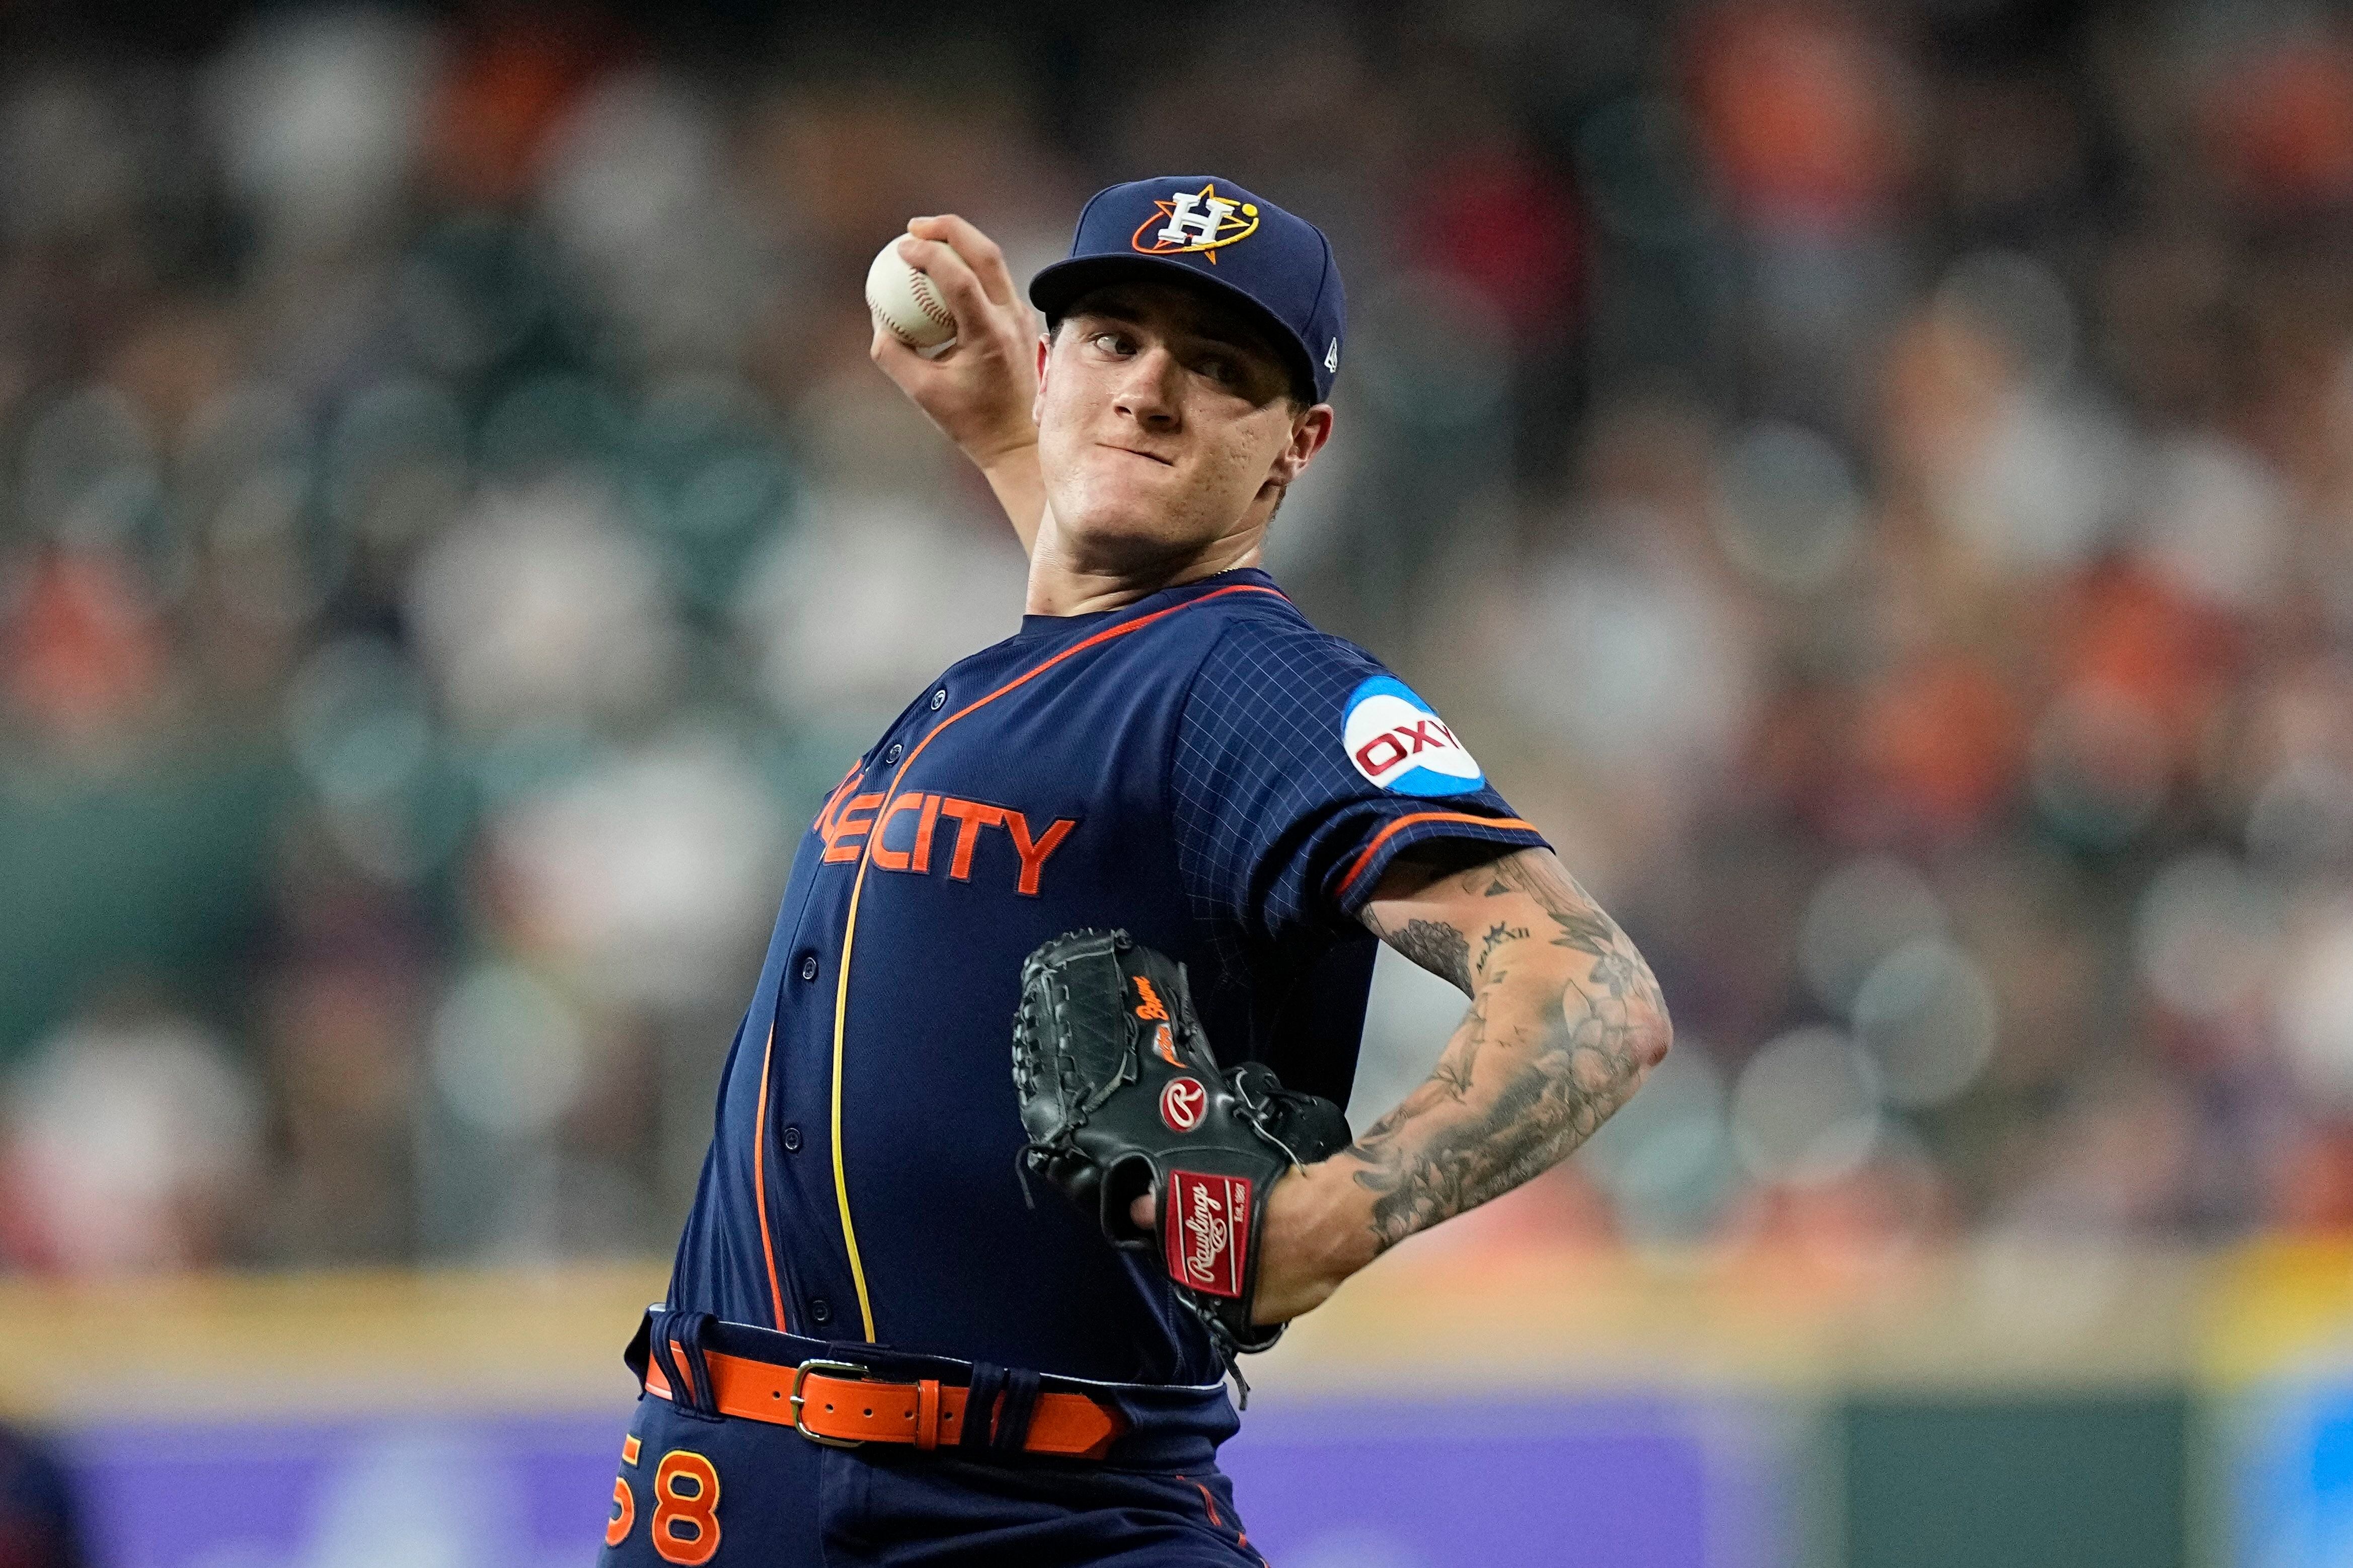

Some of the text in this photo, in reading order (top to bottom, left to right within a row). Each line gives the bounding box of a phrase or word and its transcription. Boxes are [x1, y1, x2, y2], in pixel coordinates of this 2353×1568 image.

[1158, 192, 1235, 246] H
[1356, 721, 1460, 776] OXY
[1185, 1182, 1222, 1283] Rawlings
